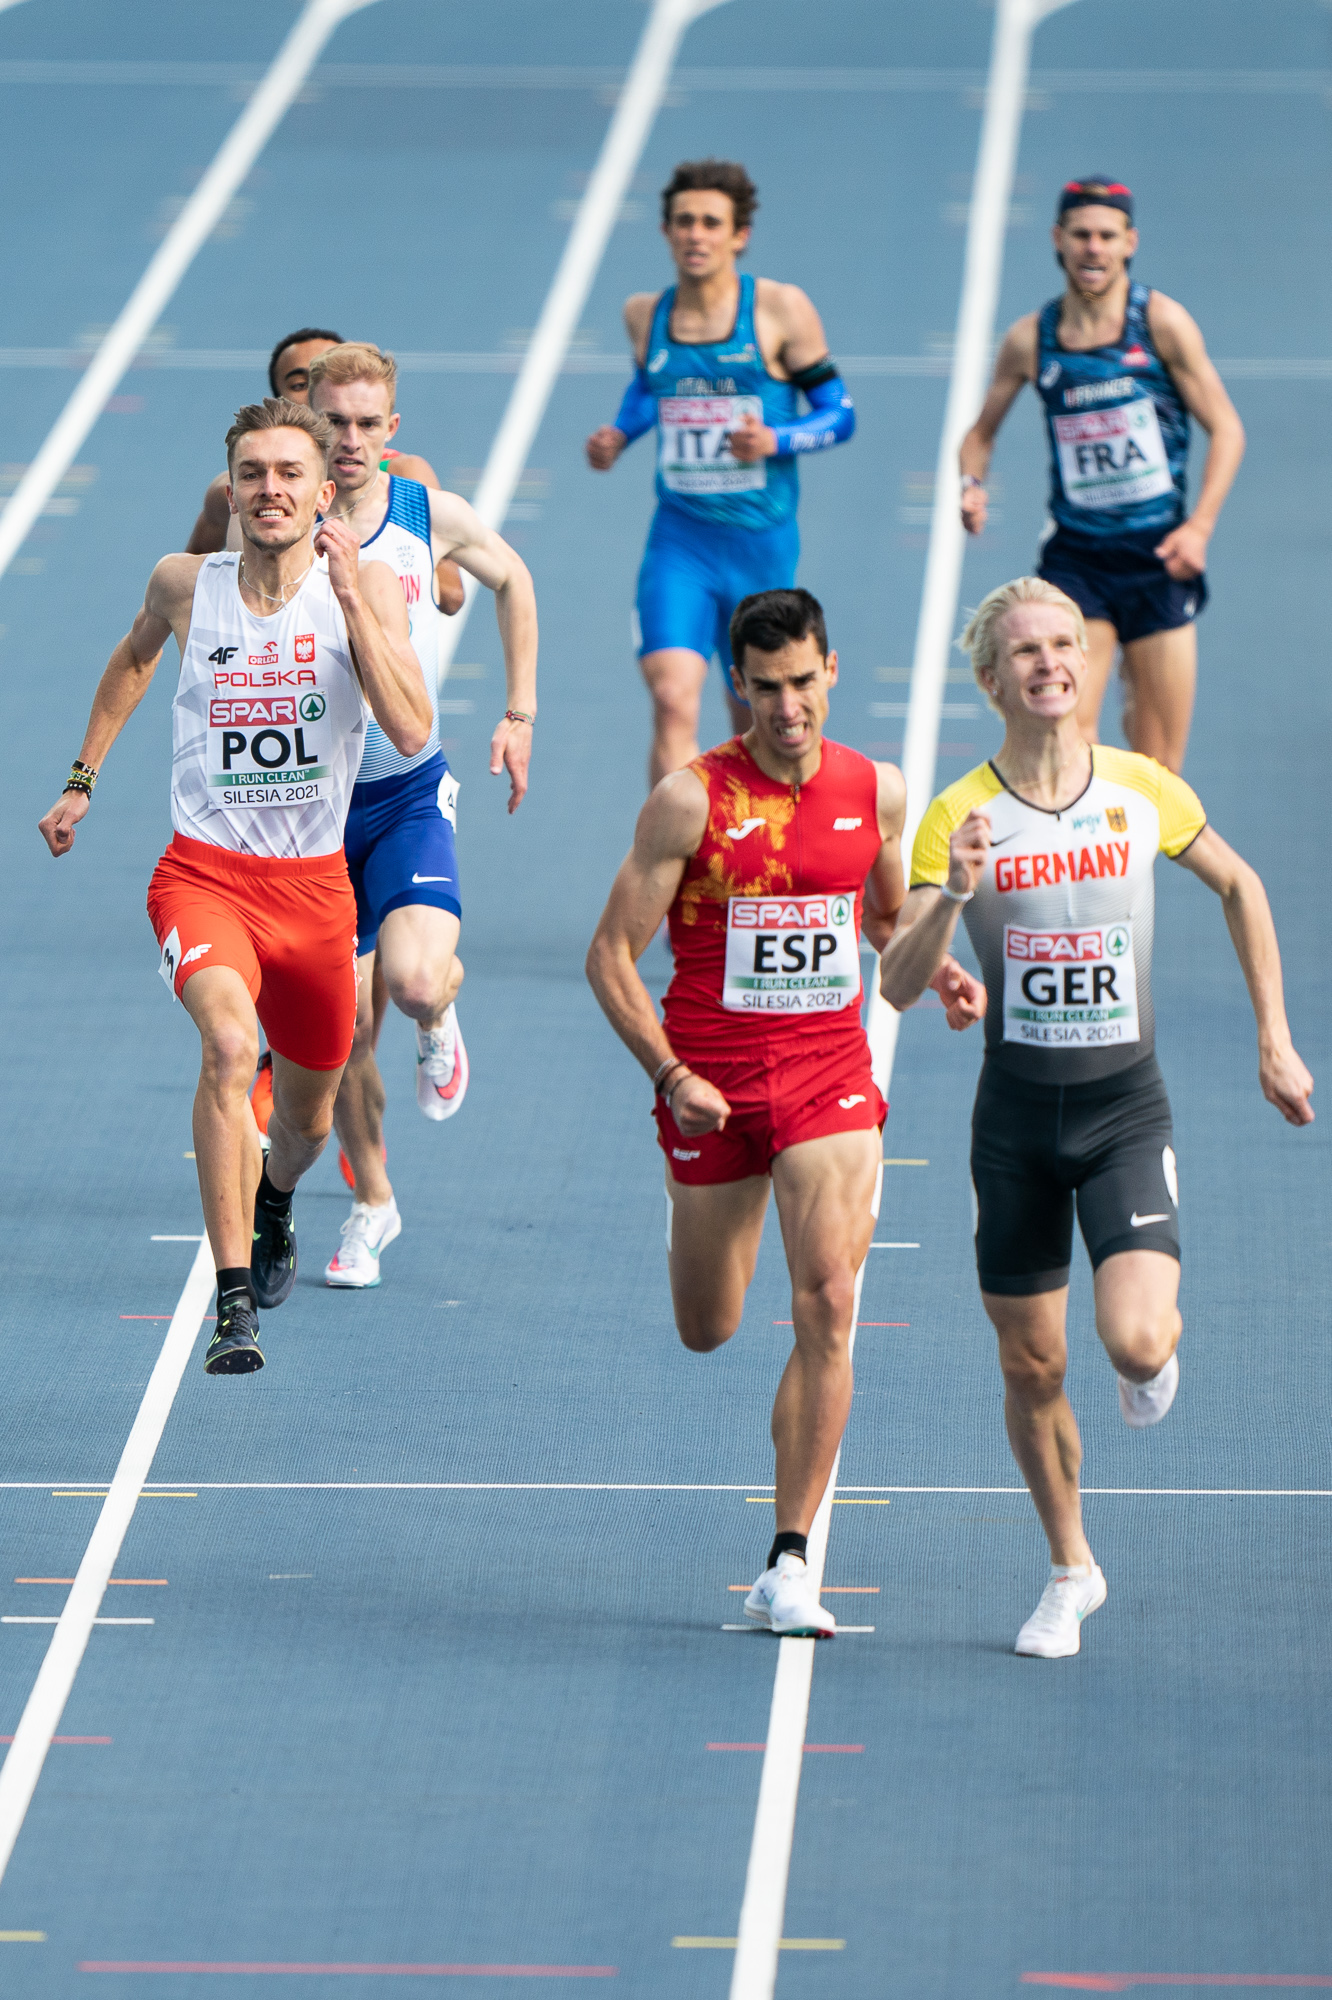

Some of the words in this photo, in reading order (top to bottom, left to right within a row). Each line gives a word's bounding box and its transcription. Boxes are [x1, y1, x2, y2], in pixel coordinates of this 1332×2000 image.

[1075, 438, 1147, 476] FRA
[208, 646, 239, 665] 4F
[249, 655, 278, 665] ORLEN
[214, 669, 317, 689] POLSKA
[211, 699, 295, 724] SPAR
[222, 727, 318, 770] POL
[232, 775, 236, 784] I
[239, 773, 264, 784] RUN
[223, 789, 282, 804] SILESIA
[285, 784, 319, 801] 2021
[994, 841, 1130, 893] GERMANY
[733, 902, 827, 927] SPAR
[753, 933, 837, 974] ESP
[1008, 931, 1102, 960] SPAR
[753, 978, 758, 989] I
[760, 977, 788, 989] RUN
[1021, 965, 1121, 1006] GER
[742, 993, 803, 1009] SILESIA
[806, 992, 842, 1007] 2021
[1037, 1009, 1063, 1021] RUN
[1020, 1024, 1082, 1041] SILESIA
[1086, 1024, 1122, 1041] 2021
